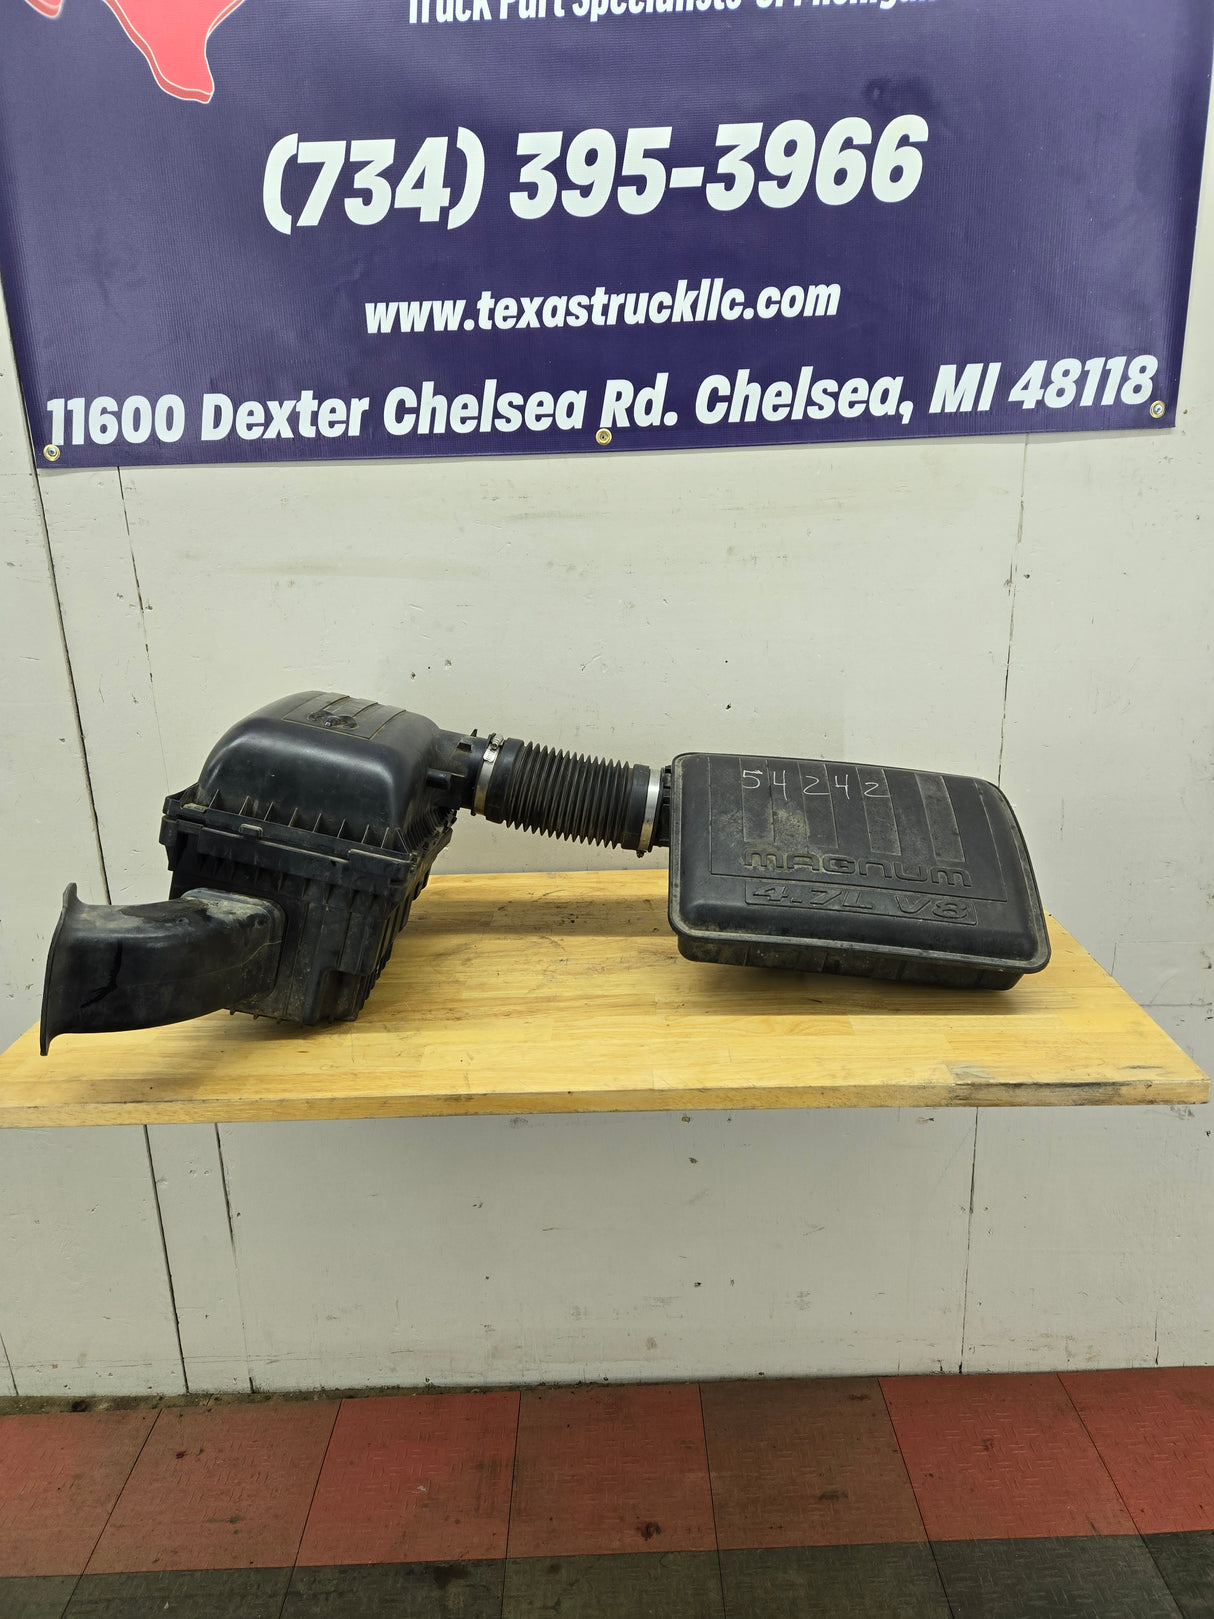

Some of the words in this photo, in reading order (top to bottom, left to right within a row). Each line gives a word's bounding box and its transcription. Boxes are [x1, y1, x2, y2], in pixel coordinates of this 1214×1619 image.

[263, 126, 485, 235] (734)
[510, 114, 929, 220] 395-3966
[365, 277, 841, 335] www.texastruckllc.com
[46, 393, 187, 446] 11600
[200, 389, 370, 442] Dexter
[383, 378, 588, 436] Chelsea
[599, 372, 678, 429] Rd.
[695, 364, 914, 426] Chelsea,
[928, 362, 1002, 414] MI
[1007, 354, 1159, 411] 48118
[742, 769, 891, 801] 54242
[752, 883, 873, 910] 4.7L
[895, 894, 968, 920] V8
